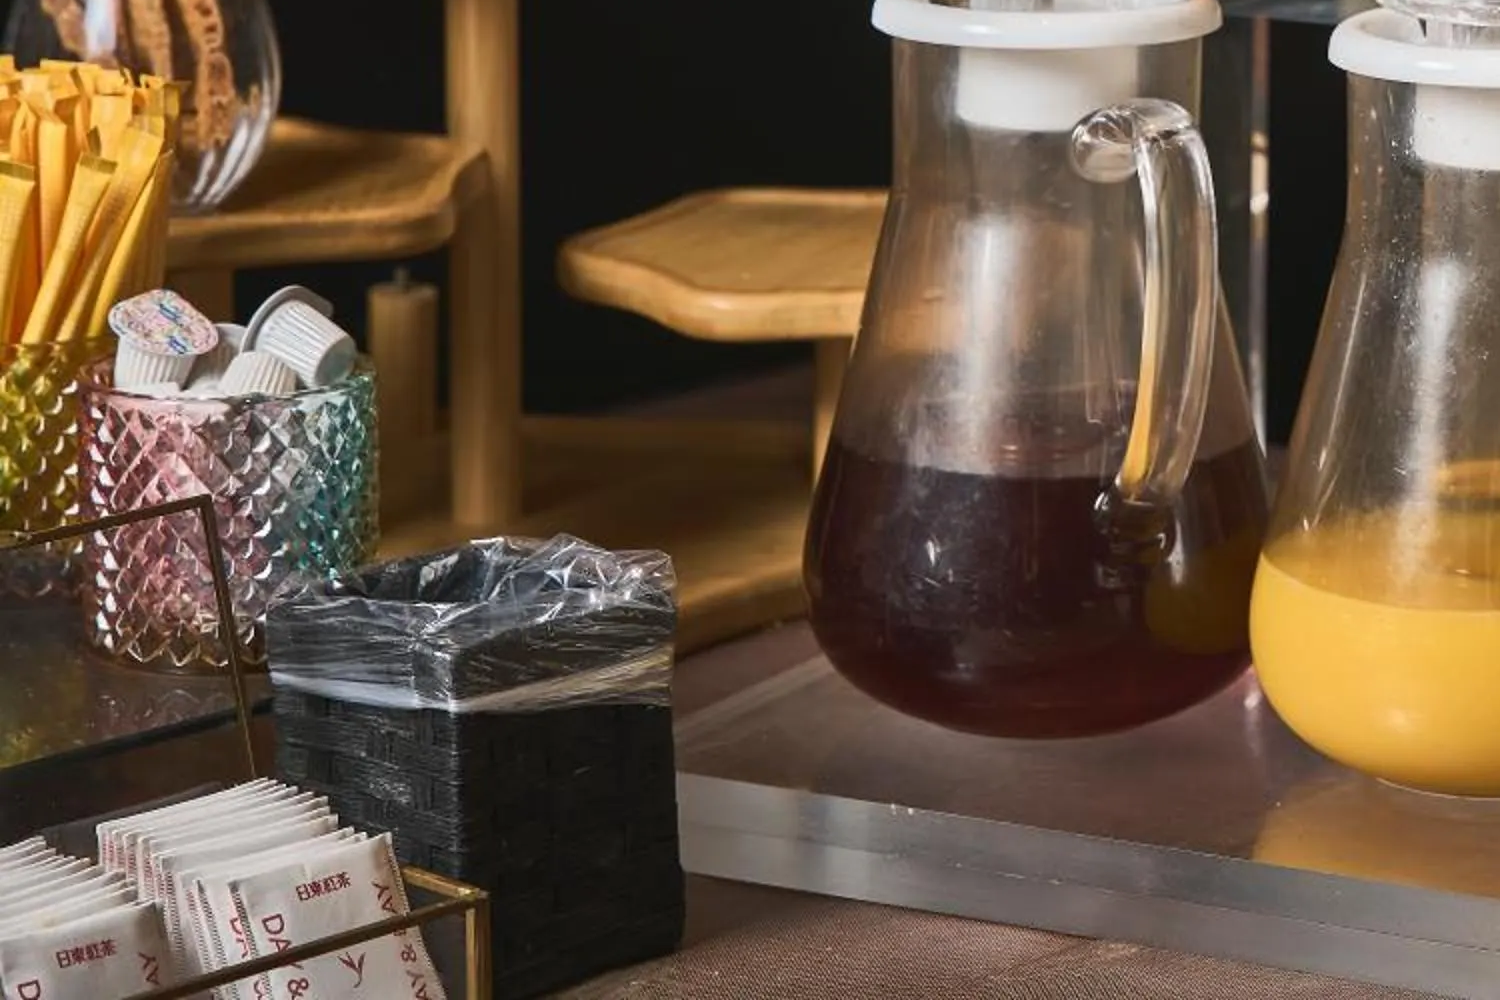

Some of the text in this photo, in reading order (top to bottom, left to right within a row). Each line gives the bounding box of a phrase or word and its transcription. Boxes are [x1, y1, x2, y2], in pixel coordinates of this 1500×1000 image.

[295, 871, 351, 901] 日東紅茶
[56, 938, 117, 969] 日東紅茶
